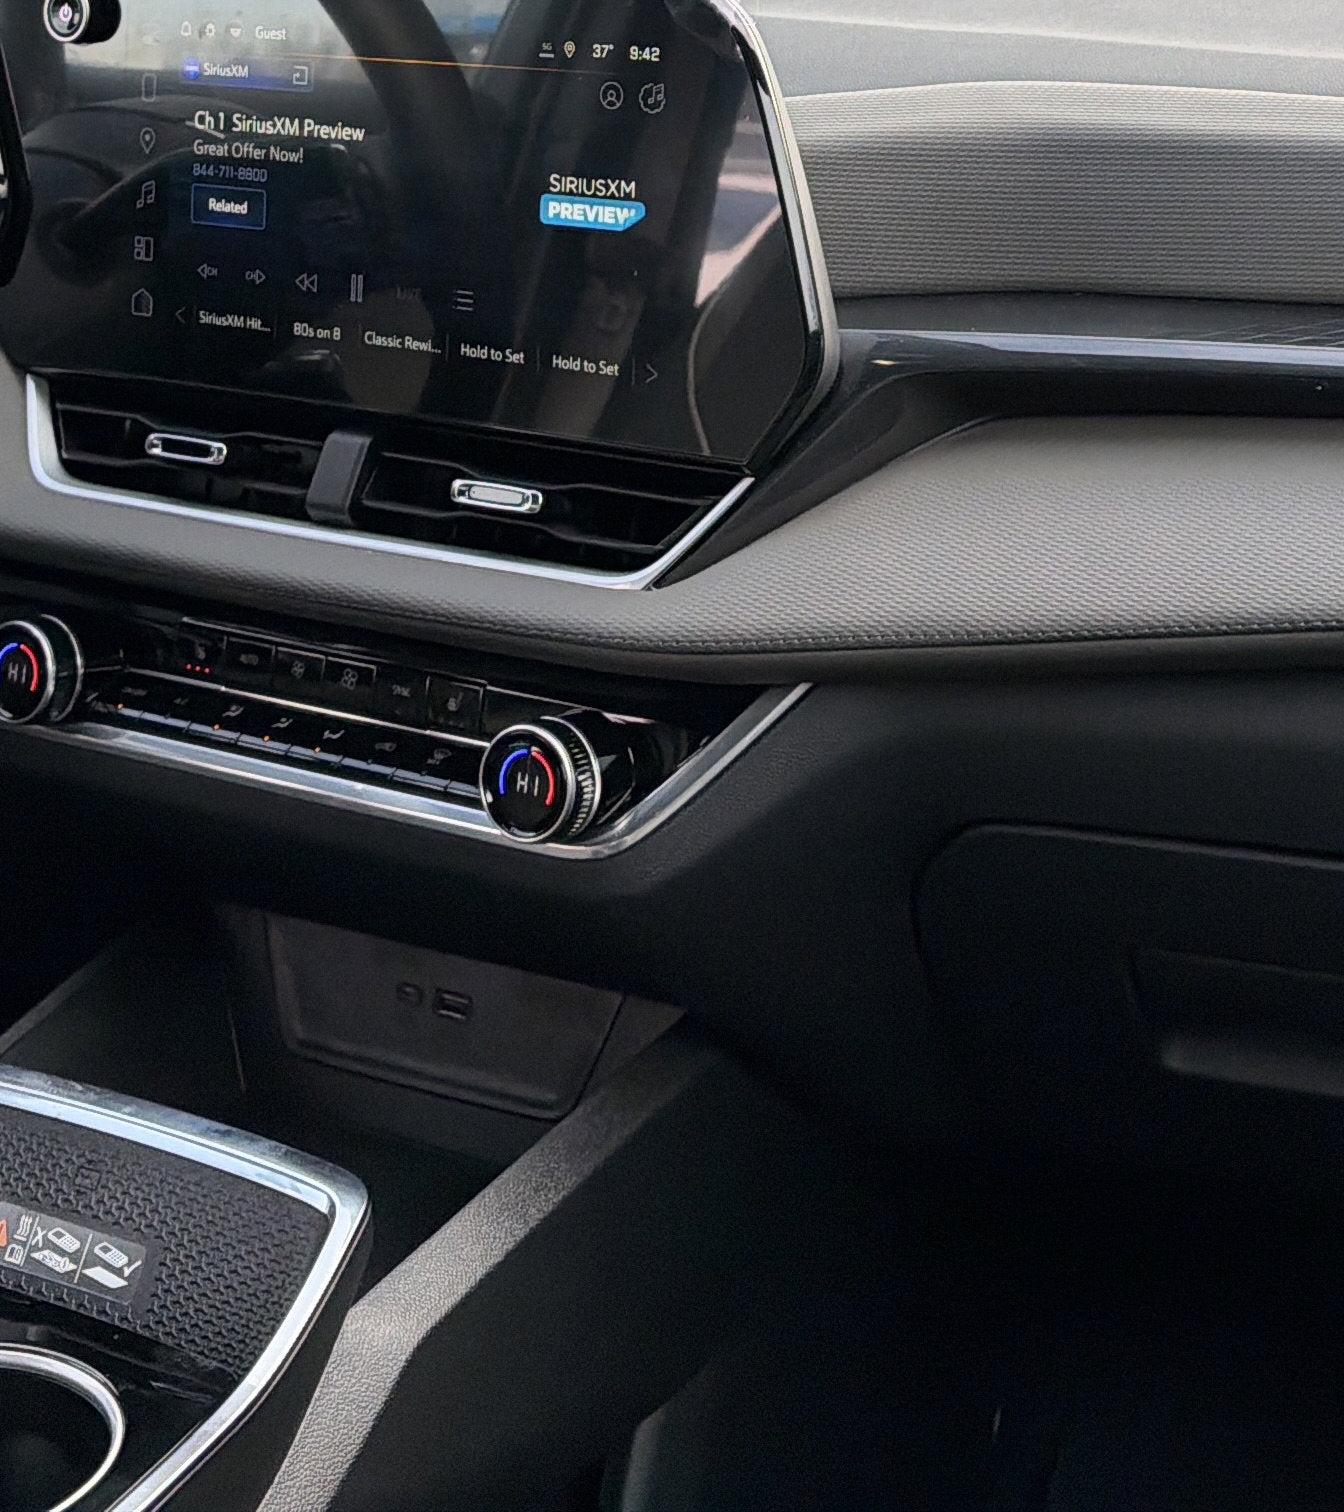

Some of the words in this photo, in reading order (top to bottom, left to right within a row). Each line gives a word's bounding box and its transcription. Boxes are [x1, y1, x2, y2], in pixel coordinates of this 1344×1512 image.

[255, 25, 287, 40] Guest
[593, 43, 614, 59] 37°
[629, 45, 661, 62] 9:42
[203, 62, 249, 78] SiriusXM
[194, 110, 214, 130] Ch
[218, 111, 225, 131] 1
[231, 113, 300, 137] SiriusXM
[303, 119, 366, 142] Preview
[193, 139, 229, 157] Great
[231, 141, 267, 160] Offer
[269, 145, 304, 164] Now!
[193, 163, 268, 183] 844-711-8800
[549, 173, 636, 199] SIRIUSXM
[208, 197, 248, 215] Related
[547, 200, 636, 225] PREVIEW
[199, 310, 244, 329] SiriusXM
[246, 317, 271, 332] Hit...
[293, 322, 315, 338] 80s
[316, 327, 330, 339] on
[333, 326, 342, 340] 8
[364, 331, 402, 348] Classic
[404, 335, 442, 354] Rewi...
[460, 342, 488, 359] Hold
[490, 347, 503, 362] to
[505, 348, 525, 364] Set
[552, 354, 581, 371] Hold
[583, 359, 596, 374] to
[598, 360, 619, 377] Set
[516, 771, 539, 797] HI
